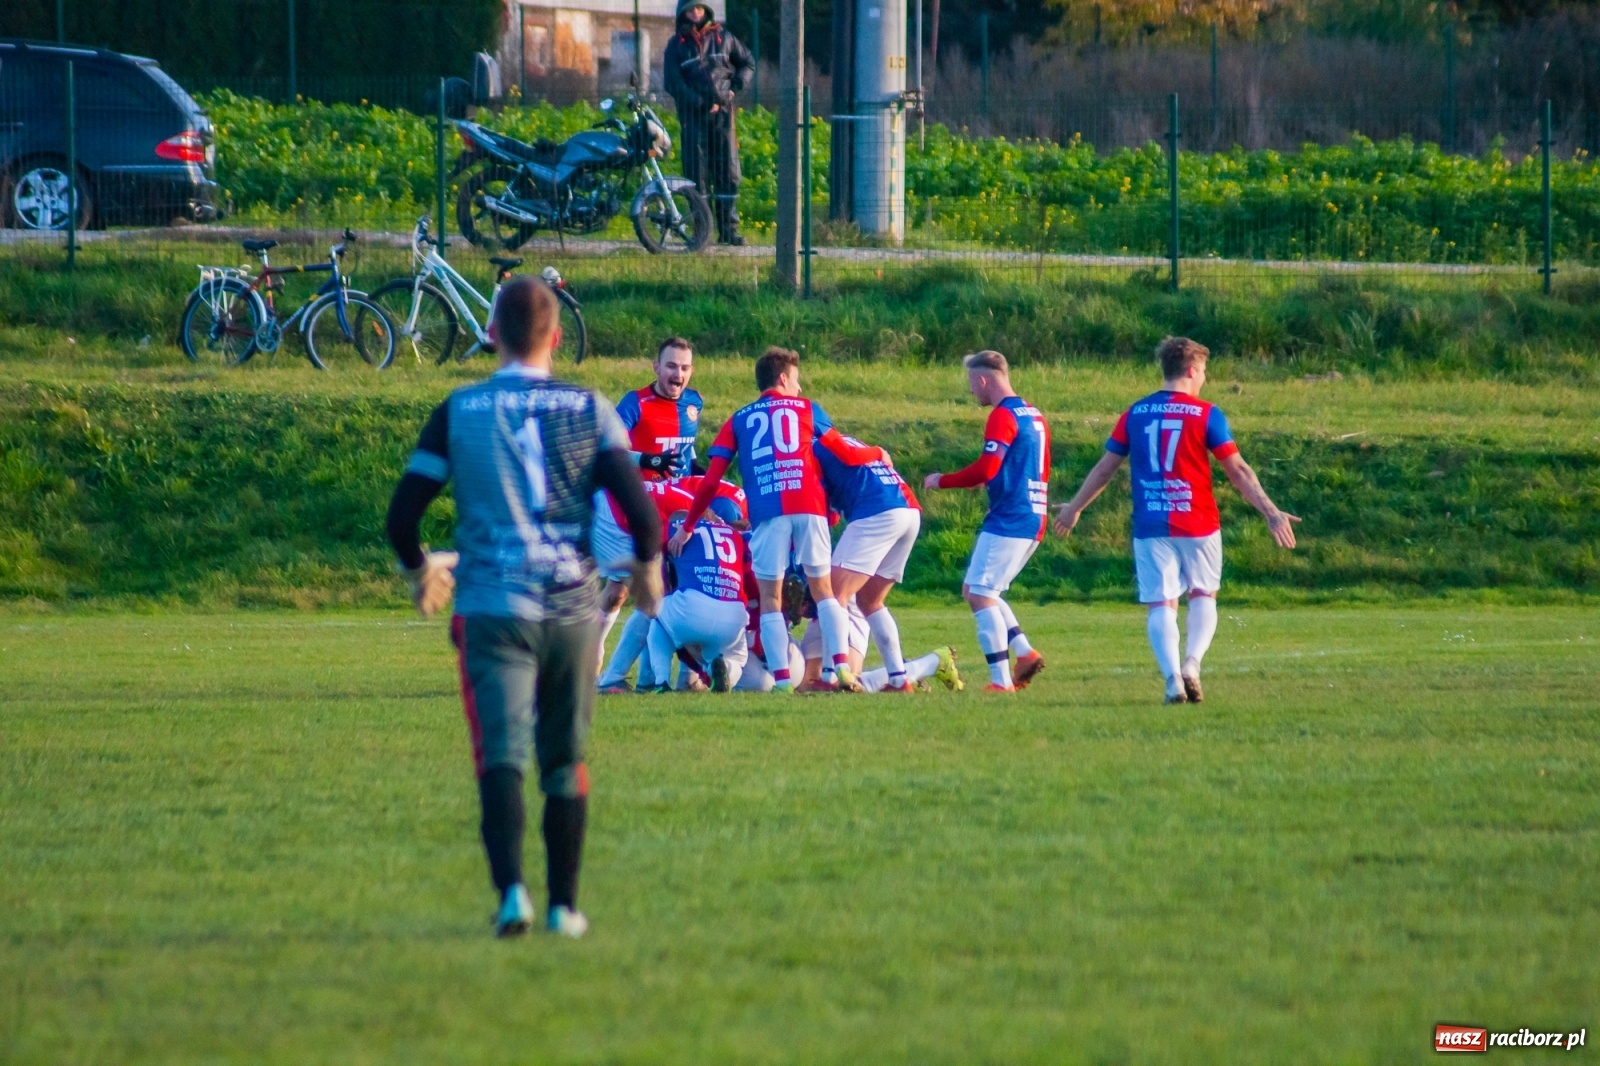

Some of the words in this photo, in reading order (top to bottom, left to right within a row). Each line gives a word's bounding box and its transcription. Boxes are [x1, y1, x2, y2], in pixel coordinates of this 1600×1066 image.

[746, 407, 800, 460] 20
[1144, 419, 1184, 473] 17
[514, 416, 546, 511] 1
[754, 462, 772, 475] Pomoc
[774, 481, 786, 491] 297
[693, 526, 737, 564] 15
